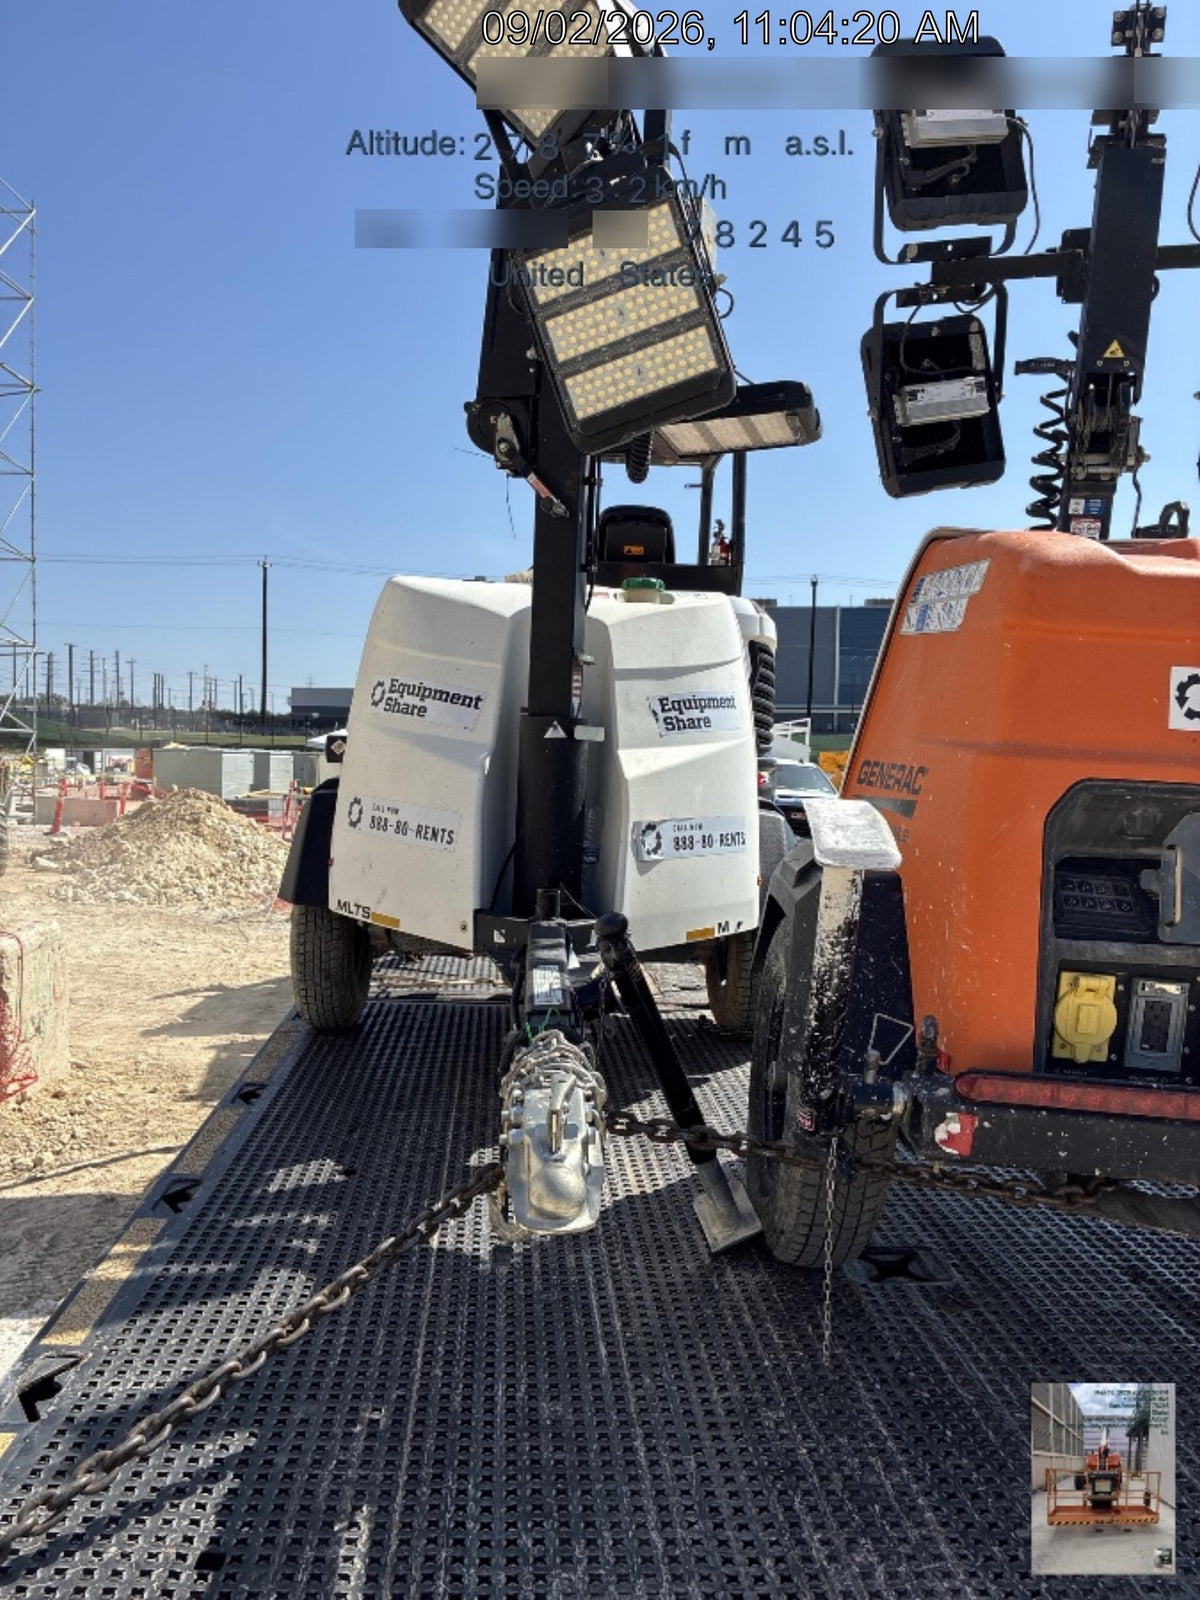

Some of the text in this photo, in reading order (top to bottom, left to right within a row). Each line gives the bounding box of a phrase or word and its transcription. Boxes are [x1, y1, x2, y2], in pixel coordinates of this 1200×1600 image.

[388, 678, 485, 711] Equipment
[657, 694, 737, 714] Equipment
[383, 696, 428, 718] Share
[662, 713, 713, 732] Share
[857, 760, 928, 795] GENERAC
[336, 899, 371, 920] MLTS
